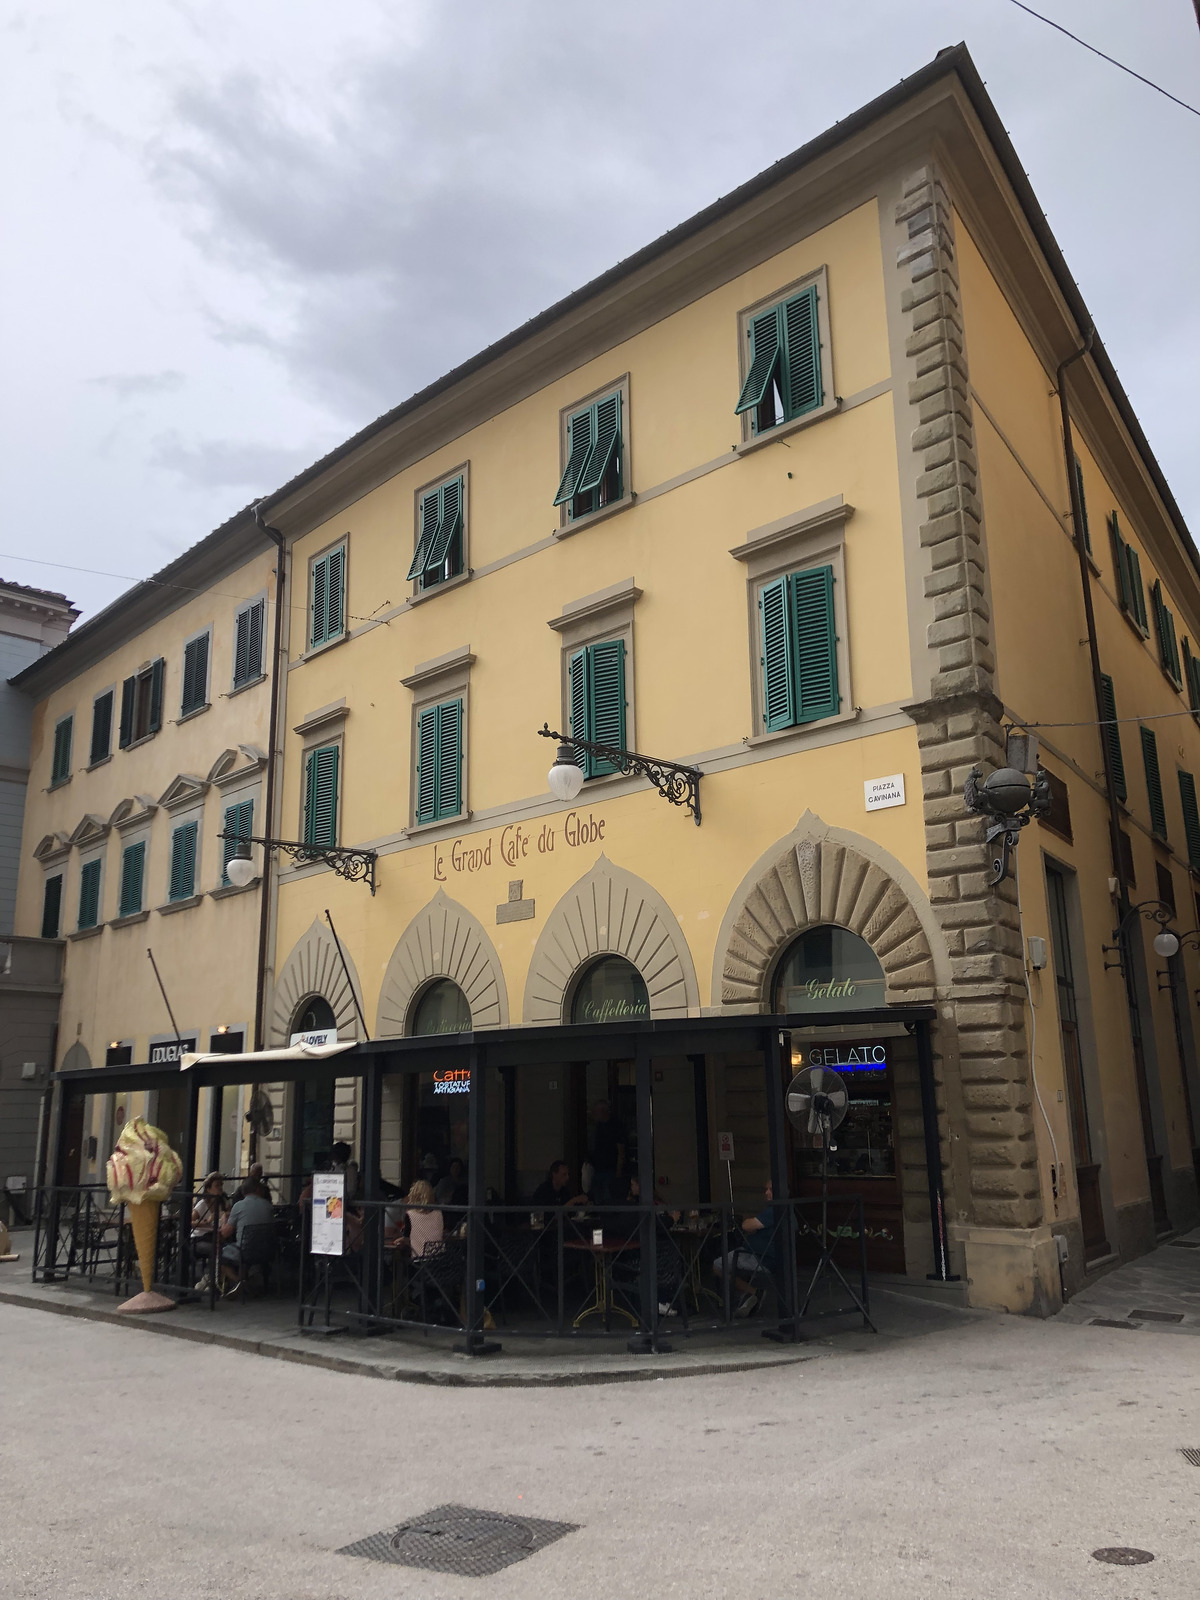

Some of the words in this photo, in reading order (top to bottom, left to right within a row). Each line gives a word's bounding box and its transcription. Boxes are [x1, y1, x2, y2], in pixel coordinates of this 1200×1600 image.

[867, 791, 901, 803] GAVINANA
[872, 782, 895, 792] PIAZZA
[451, 838, 492, 873] Grand
[500, 825, 531, 867] Café
[564, 812, 606, 847] Globe
[805, 977, 856, 1000] Gelato
[583, 998, 647, 1023] Caffetteria
[305, 1034, 328, 1045] LOVELY
[809, 1045, 886, 1066] GELATO
